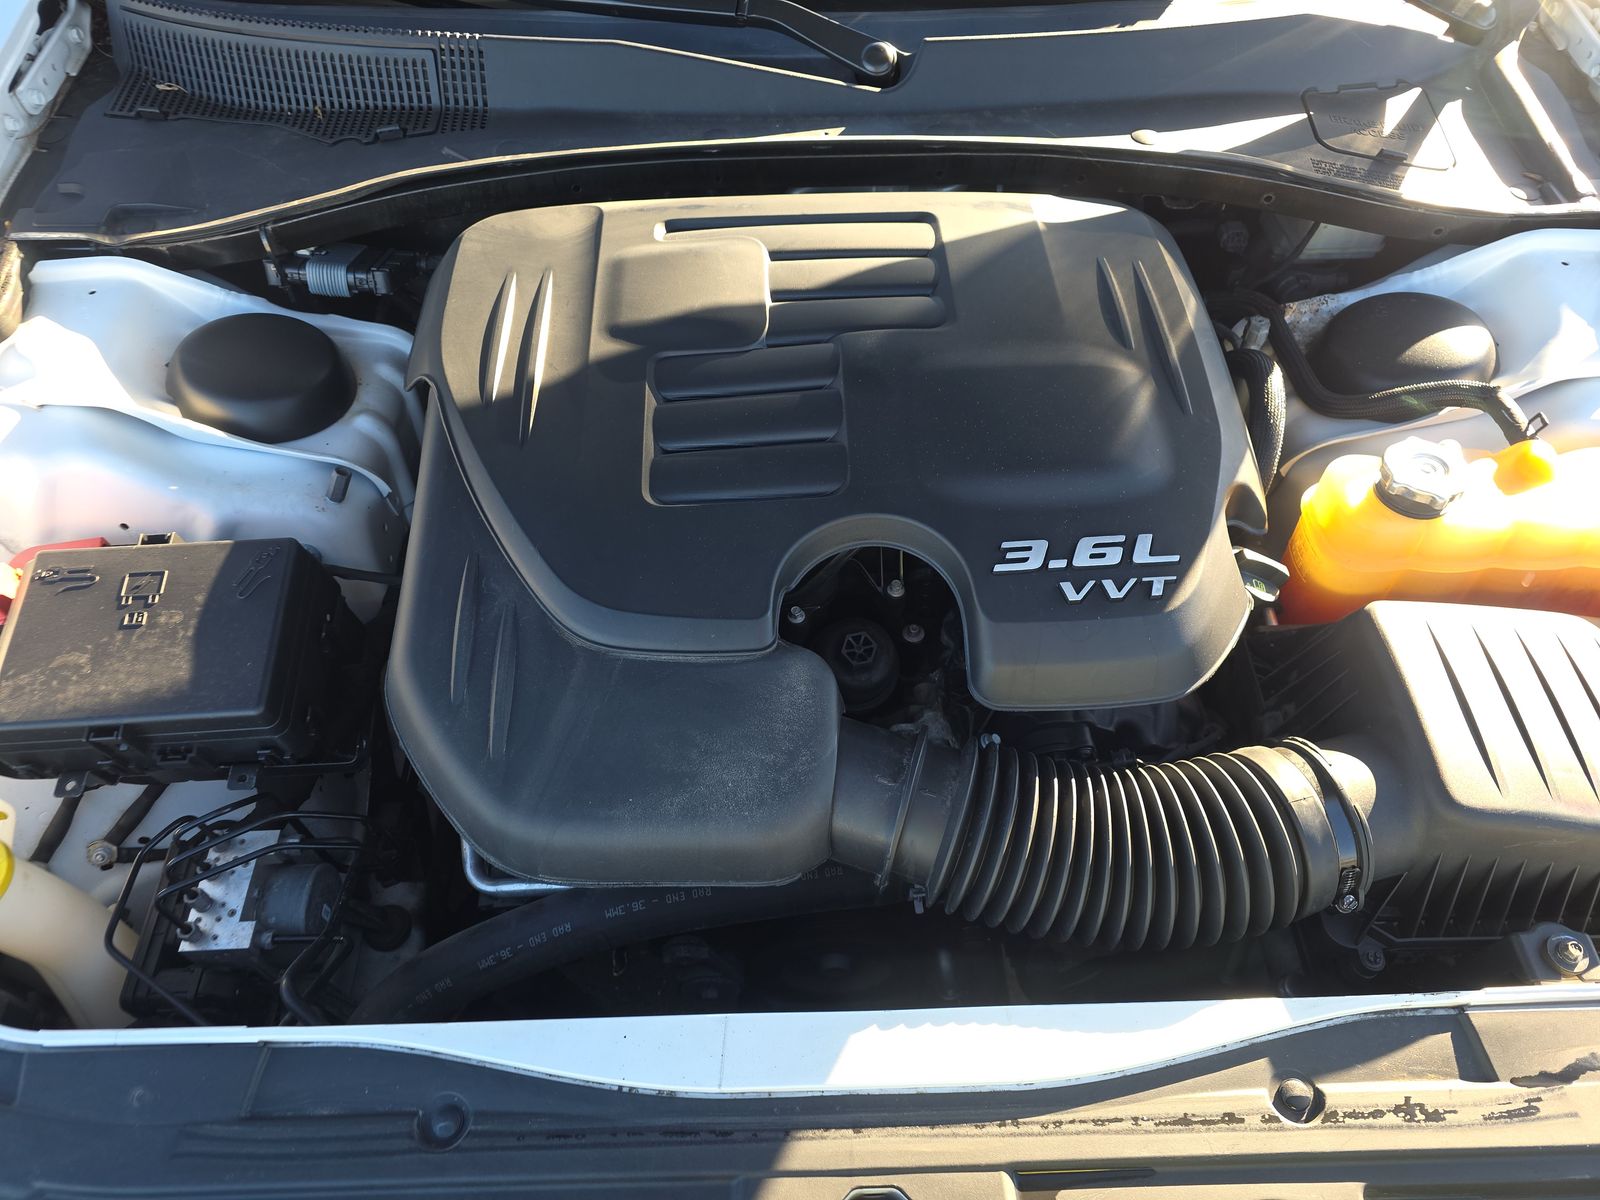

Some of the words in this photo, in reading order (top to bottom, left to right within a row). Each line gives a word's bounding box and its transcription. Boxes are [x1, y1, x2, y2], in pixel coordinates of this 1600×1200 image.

[993, 534, 1181, 574] 3.6L
[1058, 576, 1177, 602] VVT
[665, 891, 685, 904] END
[692, 886, 712, 897] RAD
[605, 899, 646, 919] 36.3MM
[551, 921, 572, 937] RAD
[528, 931, 548, 948] END
[477, 947, 513, 969] 36.3MM
